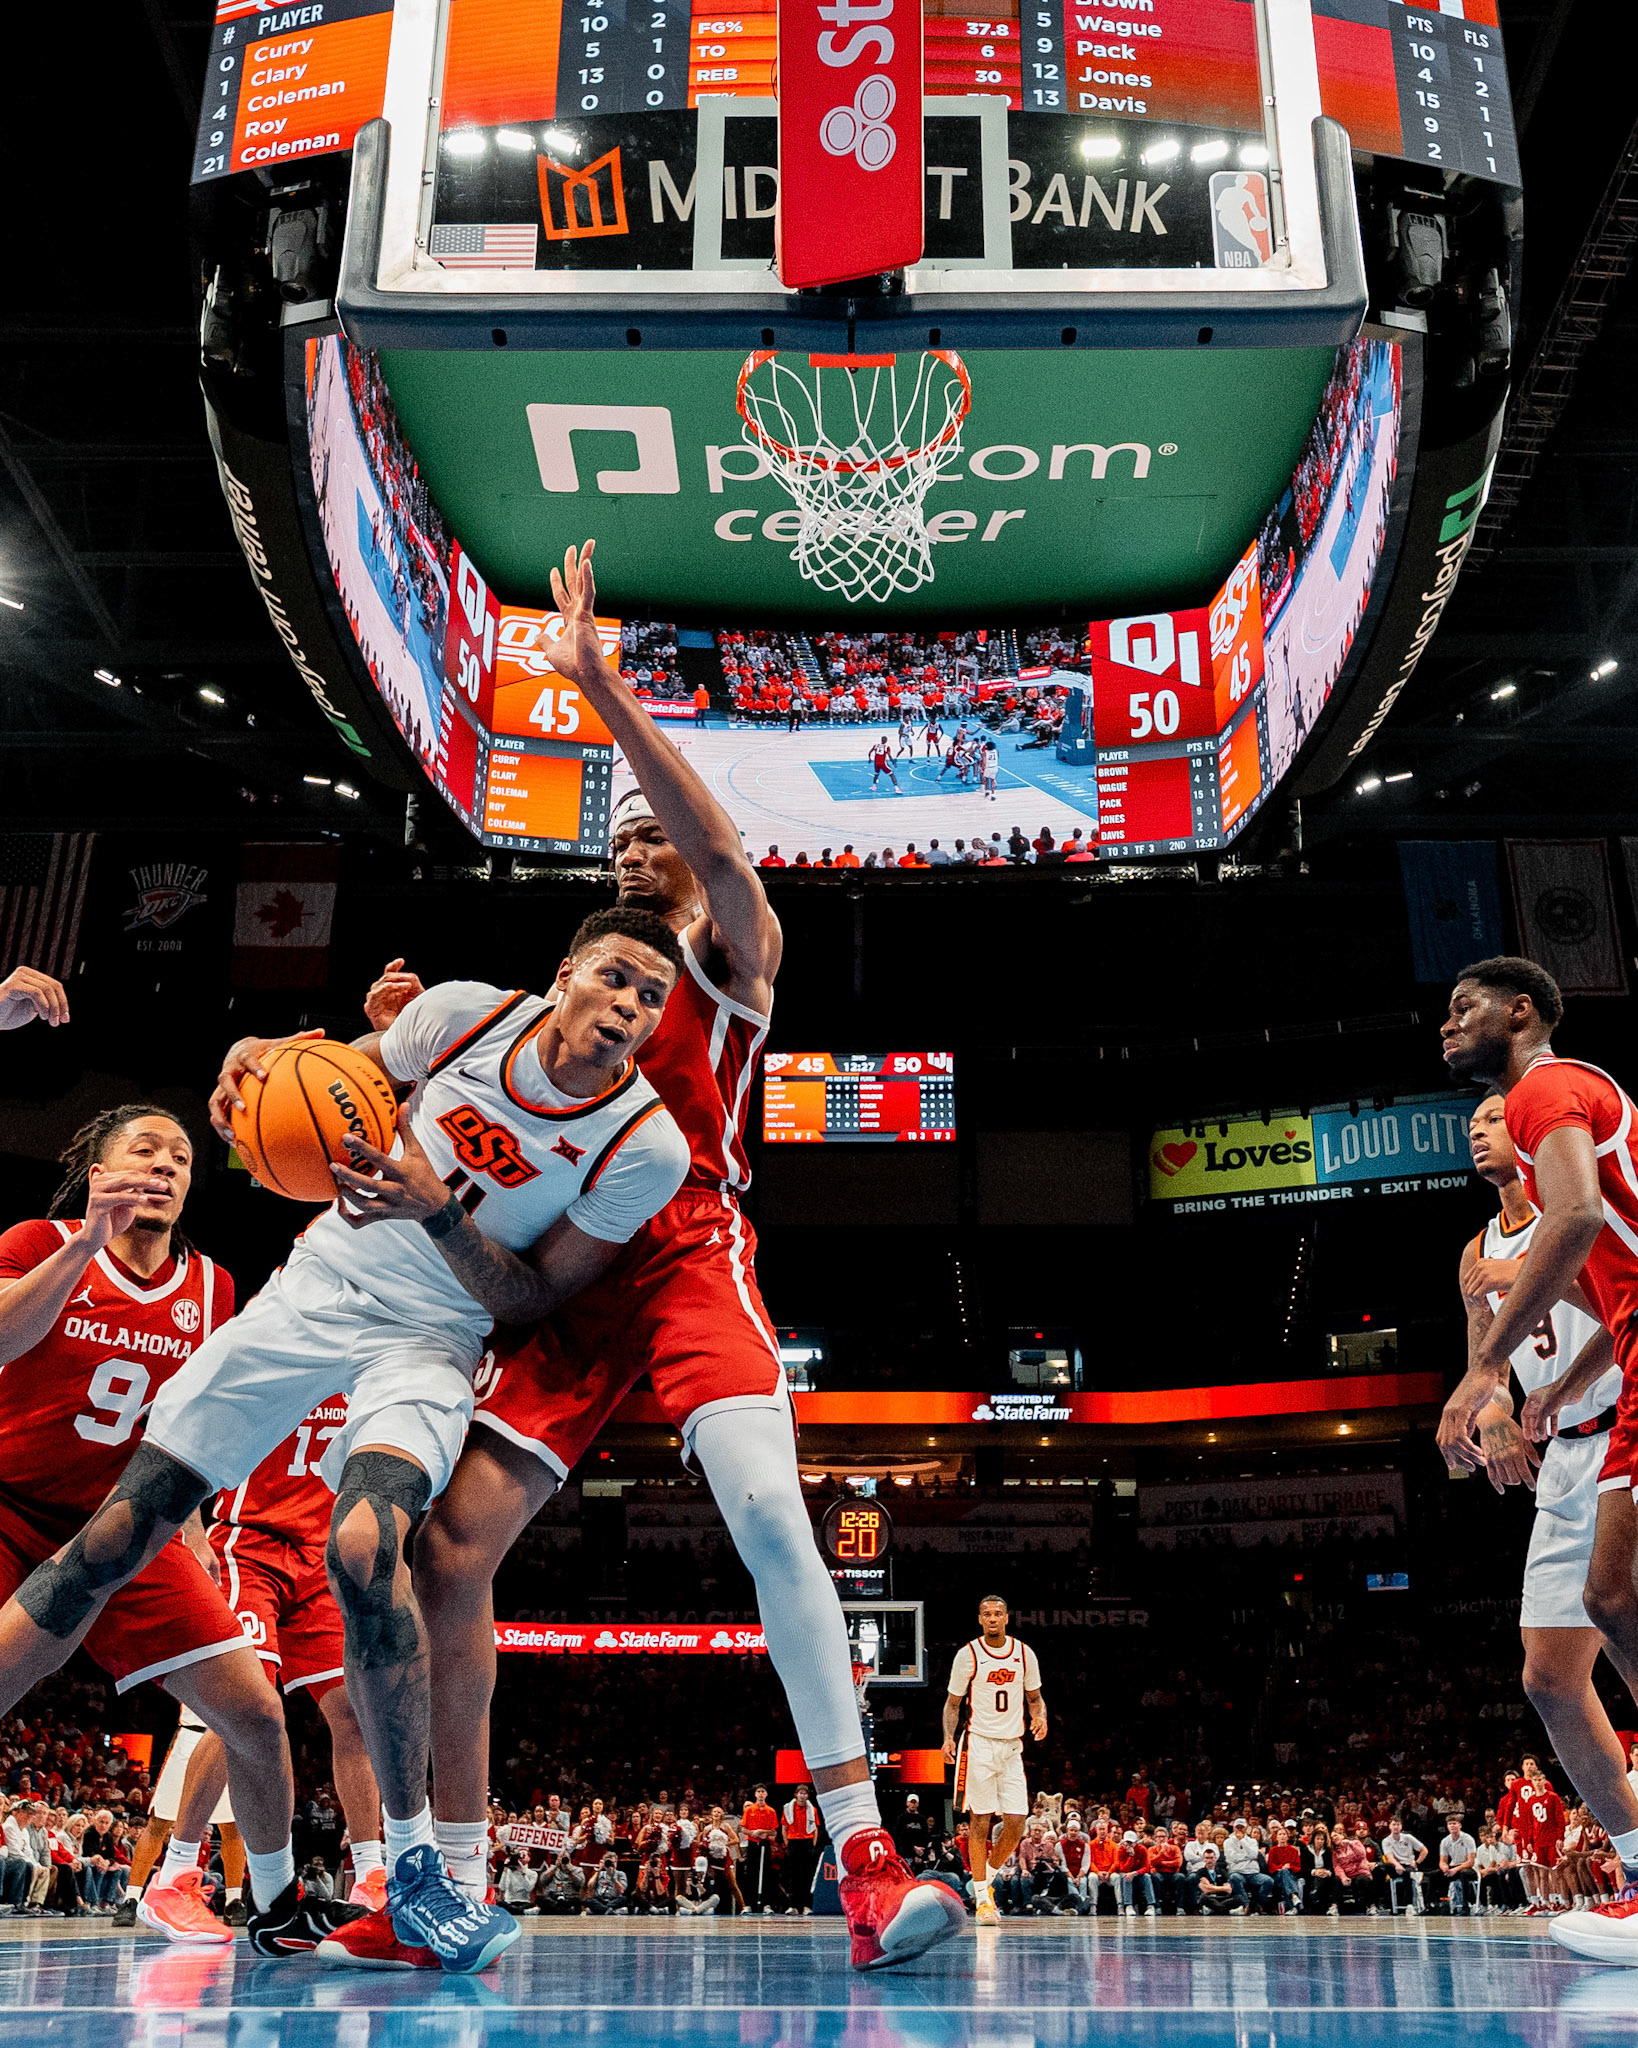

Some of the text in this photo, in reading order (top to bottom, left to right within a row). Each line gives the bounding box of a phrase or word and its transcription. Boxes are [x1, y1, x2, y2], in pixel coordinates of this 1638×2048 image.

[257, 4, 323, 35] PLAYER
[580, 12, 667, 33] 10 2
[698, 21, 743, 34] FG%
[966, 22, 1010, 36] 37.8
[1037, 12, 1163, 38] 5 Wague
[1407, 15, 1489, 48] PTS FLS
[219, 38, 313, 72] 0 Curry
[585, 37, 663, 58] 5 1
[697, 45, 726, 58] TO
[981, 45, 995, 58] 6
[1037, 38, 1136, 61] 9 Pack
[1409, 43, 1484, 72] 10 1
[219, 63, 307, 96] 1 Clary
[578, 64, 665, 85] 13 0
[697, 68, 738, 81] REB
[975, 70, 1002, 83] 30
[1032, 62, 1152, 88] 12 Jones
[1418, 67, 1489, 98] 4 2
[212, 80, 346, 121] 4 Coleman
[581, 90, 664, 110] 0 0
[1033, 89, 1059, 106] 13
[1079, 93, 1147, 113] Davis
[1415, 90, 1490, 122] 15 1
[209, 117, 288, 148] 9 Roy
[1424, 117, 1493, 147] 9 1
[201, 131, 340, 175] 21 Coleman
[1427, 143, 1497, 173] 2 1
[1224, 251, 1250, 267] NBA
[1347, 531, 1470, 757] paycom center
[456, 637, 481, 703] 50
[1230, 640, 1251, 703] 45
[529, 688, 580, 735] 45
[1129, 689, 1181, 739] 50
[494, 738, 611, 759] PLAYER PTS FL
[1098, 741, 1215, 761] PLAYER PTS FL
[492, 754, 520, 765] CURRY
[587, 764, 594, 773] 4
[1098, 757, 1214, 777] BROWN 10 1
[491, 770, 607, 790] CLARY 10 2
[1098, 772, 1215, 793] WAGUE 4 2
[490, 786, 606, 806] COLEMAN 5 1
[1099, 788, 1216, 809] PACK 15 1
[488, 802, 506, 812] ROY
[583, 812, 593, 821] 13
[1100, 804, 1217, 825] JONES 9 1
[487, 818, 526, 831] COLEMAN
[1101, 821, 1218, 841] DAVIS 2 1
[492, 835, 602, 855] TO 3 TF 2 2ND 12:27
[1107, 837, 1218, 857] TO 3 TF 3 2ND 12:27
[128, 862, 209, 892] THUNDER
[797, 1057, 825, 1073] 45
[843, 1062, 876, 1073] 12:27
[893, 1056, 922, 1073] 50
[435, 1104, 544, 1189] OSU
[1321, 1115, 1401, 1175] LOUD
[1173, 1175, 1468, 1214] BRING THE THUNDER EXIT NOW
[174, 1299, 200, 1331] SEC
[63, 1316, 193, 1361] OKLAHOMA
[73, 1358, 151, 1447] 9
[837, 1528, 878, 1558] 20
[844, 1569, 885, 1578] TISSOT
[995, 1690, 1008, 1712] 0
[508, 1824, 565, 1849] DEFENSE
